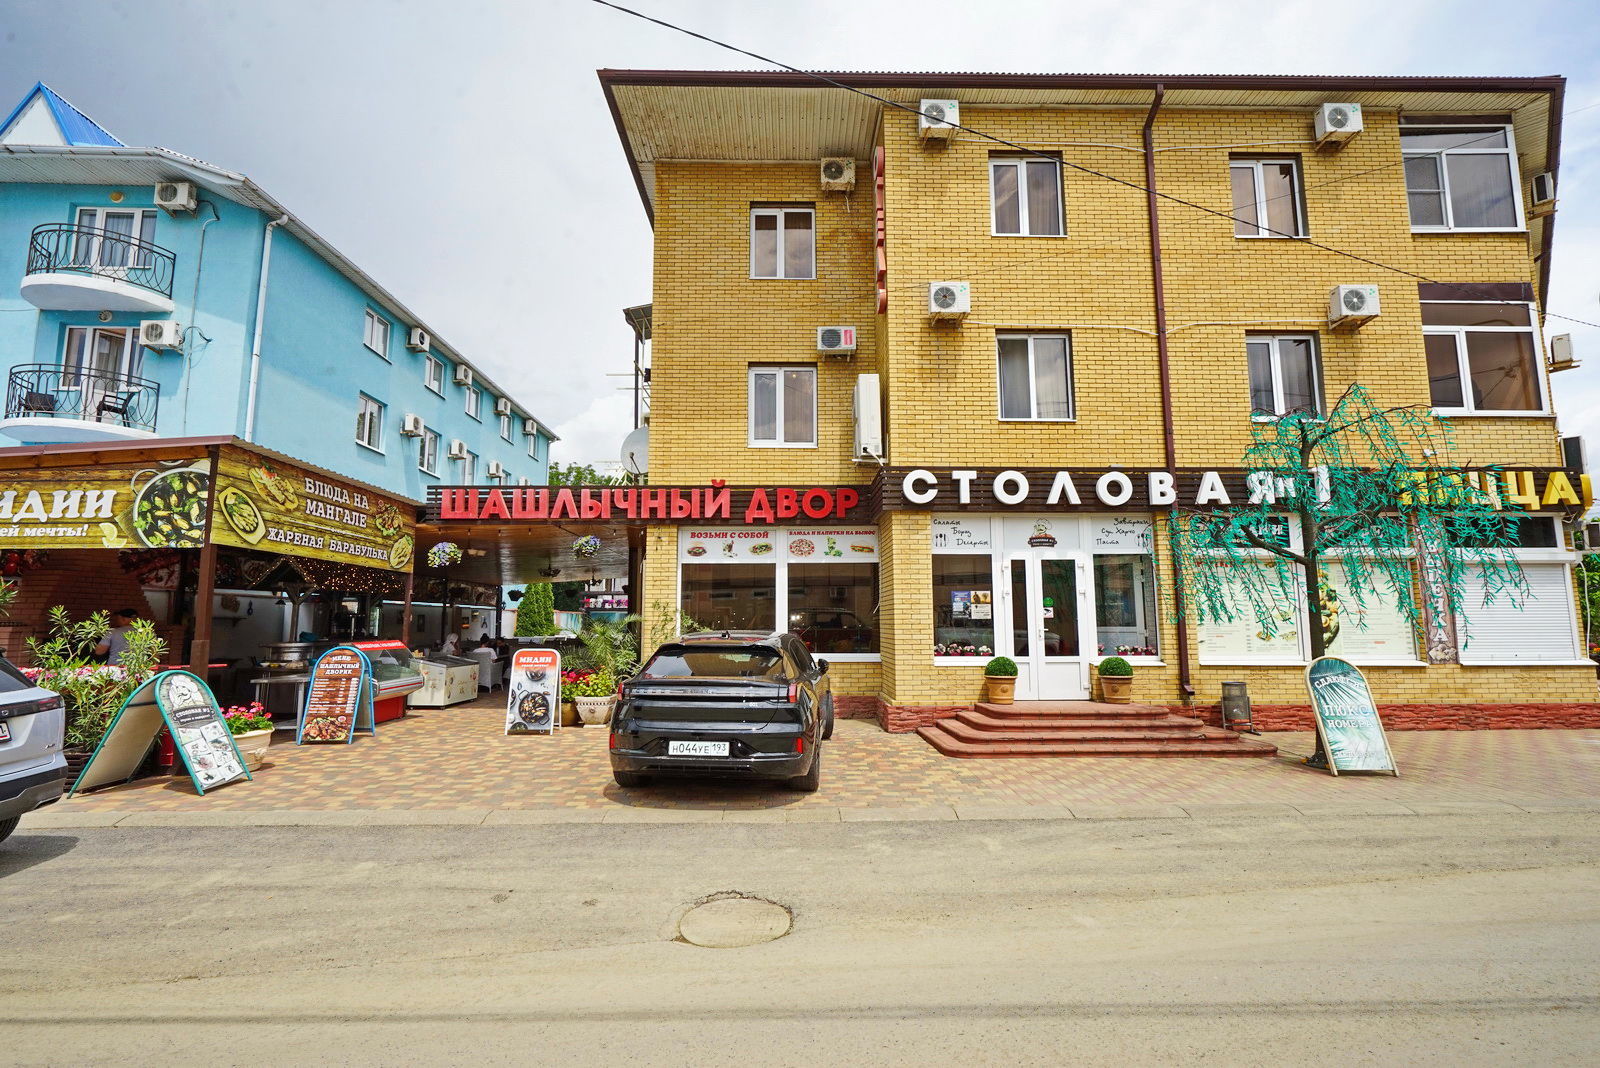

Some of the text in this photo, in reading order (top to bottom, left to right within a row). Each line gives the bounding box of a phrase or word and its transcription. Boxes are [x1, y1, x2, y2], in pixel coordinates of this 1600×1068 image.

[304, 477, 370, 509] БЛЮДА НА
[902, 468, 1276, 507] СТОЛОВАЯ
[440, 478, 859, 523] ШАШЛЫЧНЫЙ ДВОР
[305, 498, 367, 529] МАНГАЛЕ
[1113, 517, 1150, 527] Завтраки
[23, 523, 89, 537] мечты!
[690, 530, 769, 539] ВОЗЬМИ С СОБОЙ
[950, 526, 972, 538] Борщ
[267, 527, 389, 561] ЖАРЕНАЯ БАРАБУЛЬКА
[955, 538, 989, 548] Десерты
[519, 656, 552, 664] МИДИИ
[1323, 704, 1370, 717] ЛЮКС
[1327, 719, 1374, 729] НОМЕРА
[711, 743, 726, 752] 193
